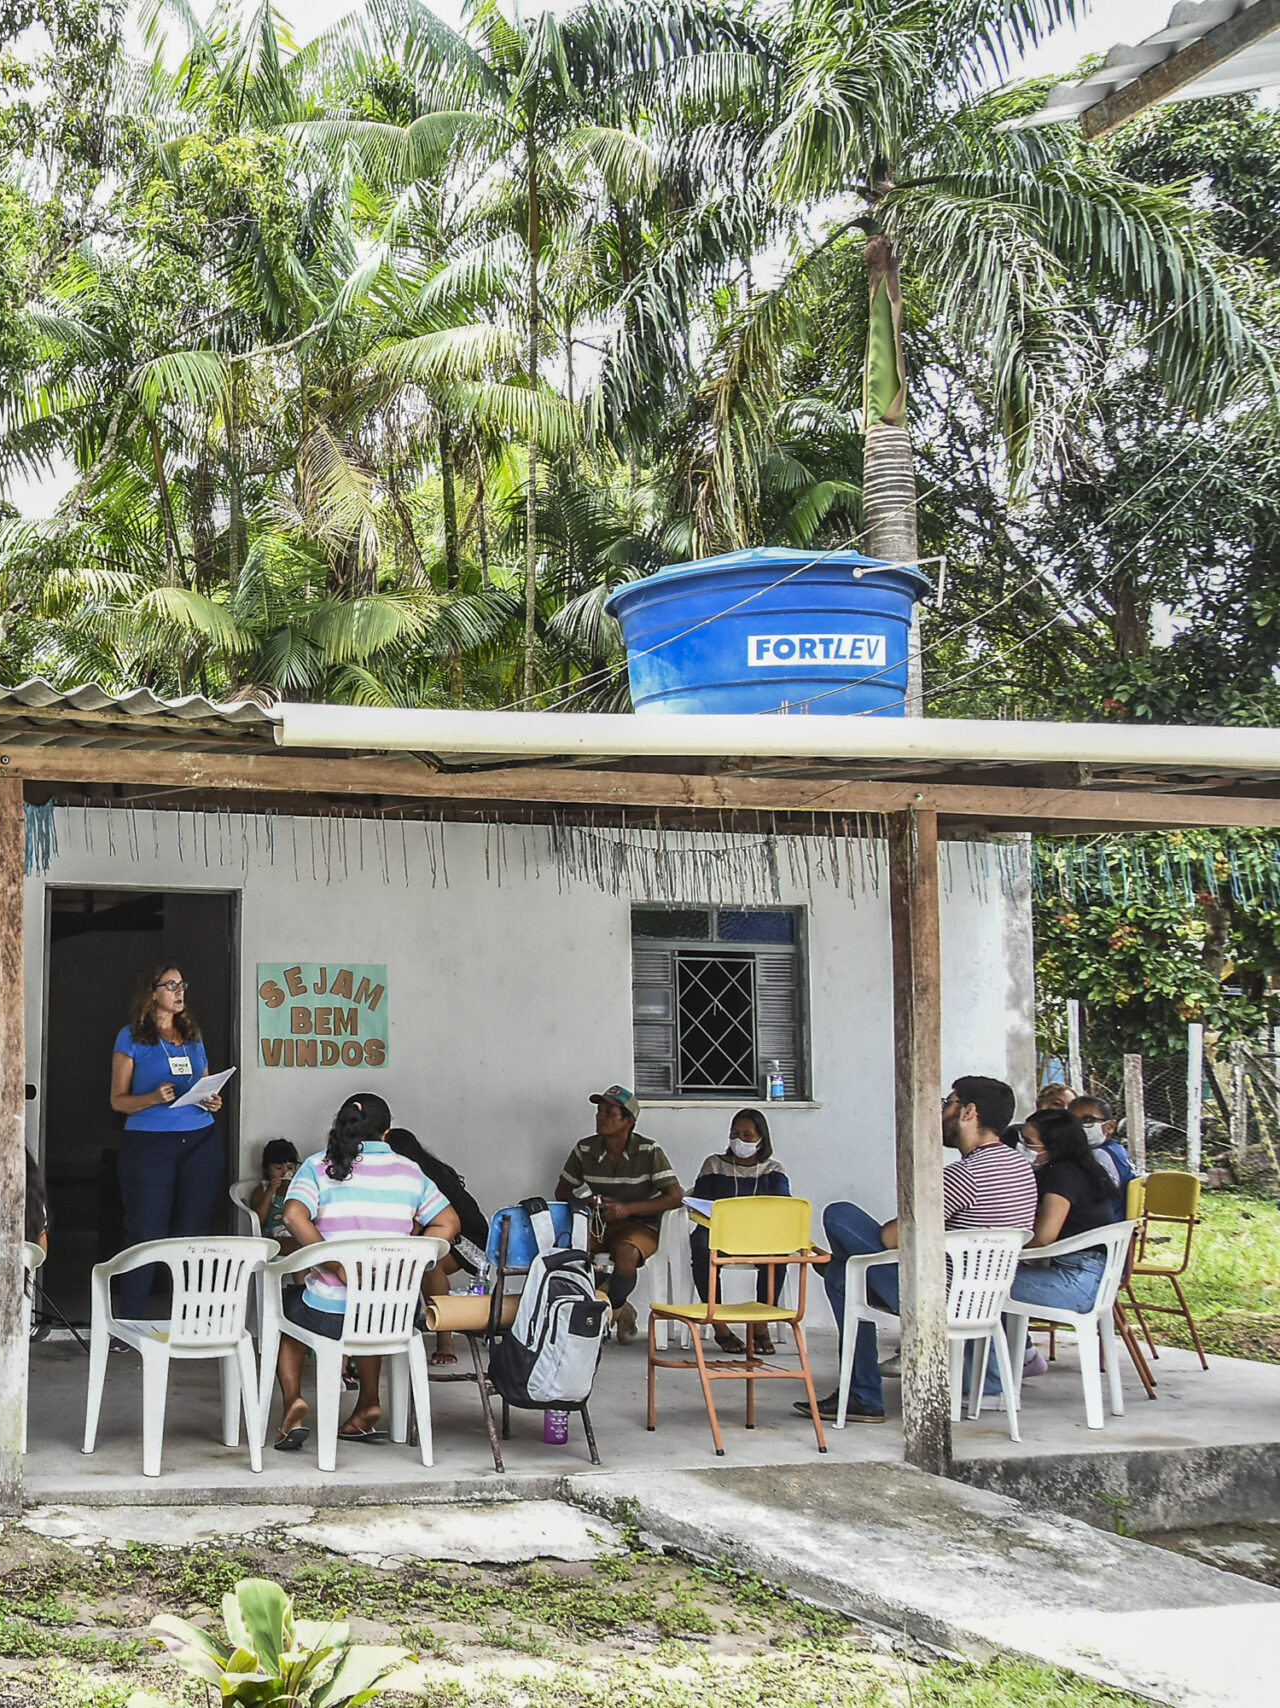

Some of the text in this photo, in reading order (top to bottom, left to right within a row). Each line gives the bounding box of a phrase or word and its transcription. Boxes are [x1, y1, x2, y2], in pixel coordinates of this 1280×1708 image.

[756, 638, 880, 660] FORTLEV
[260, 966, 385, 1011] SEJAM
[291, 1006, 358, 1036] BEM
[261, 1038, 386, 1067] VINDOS
